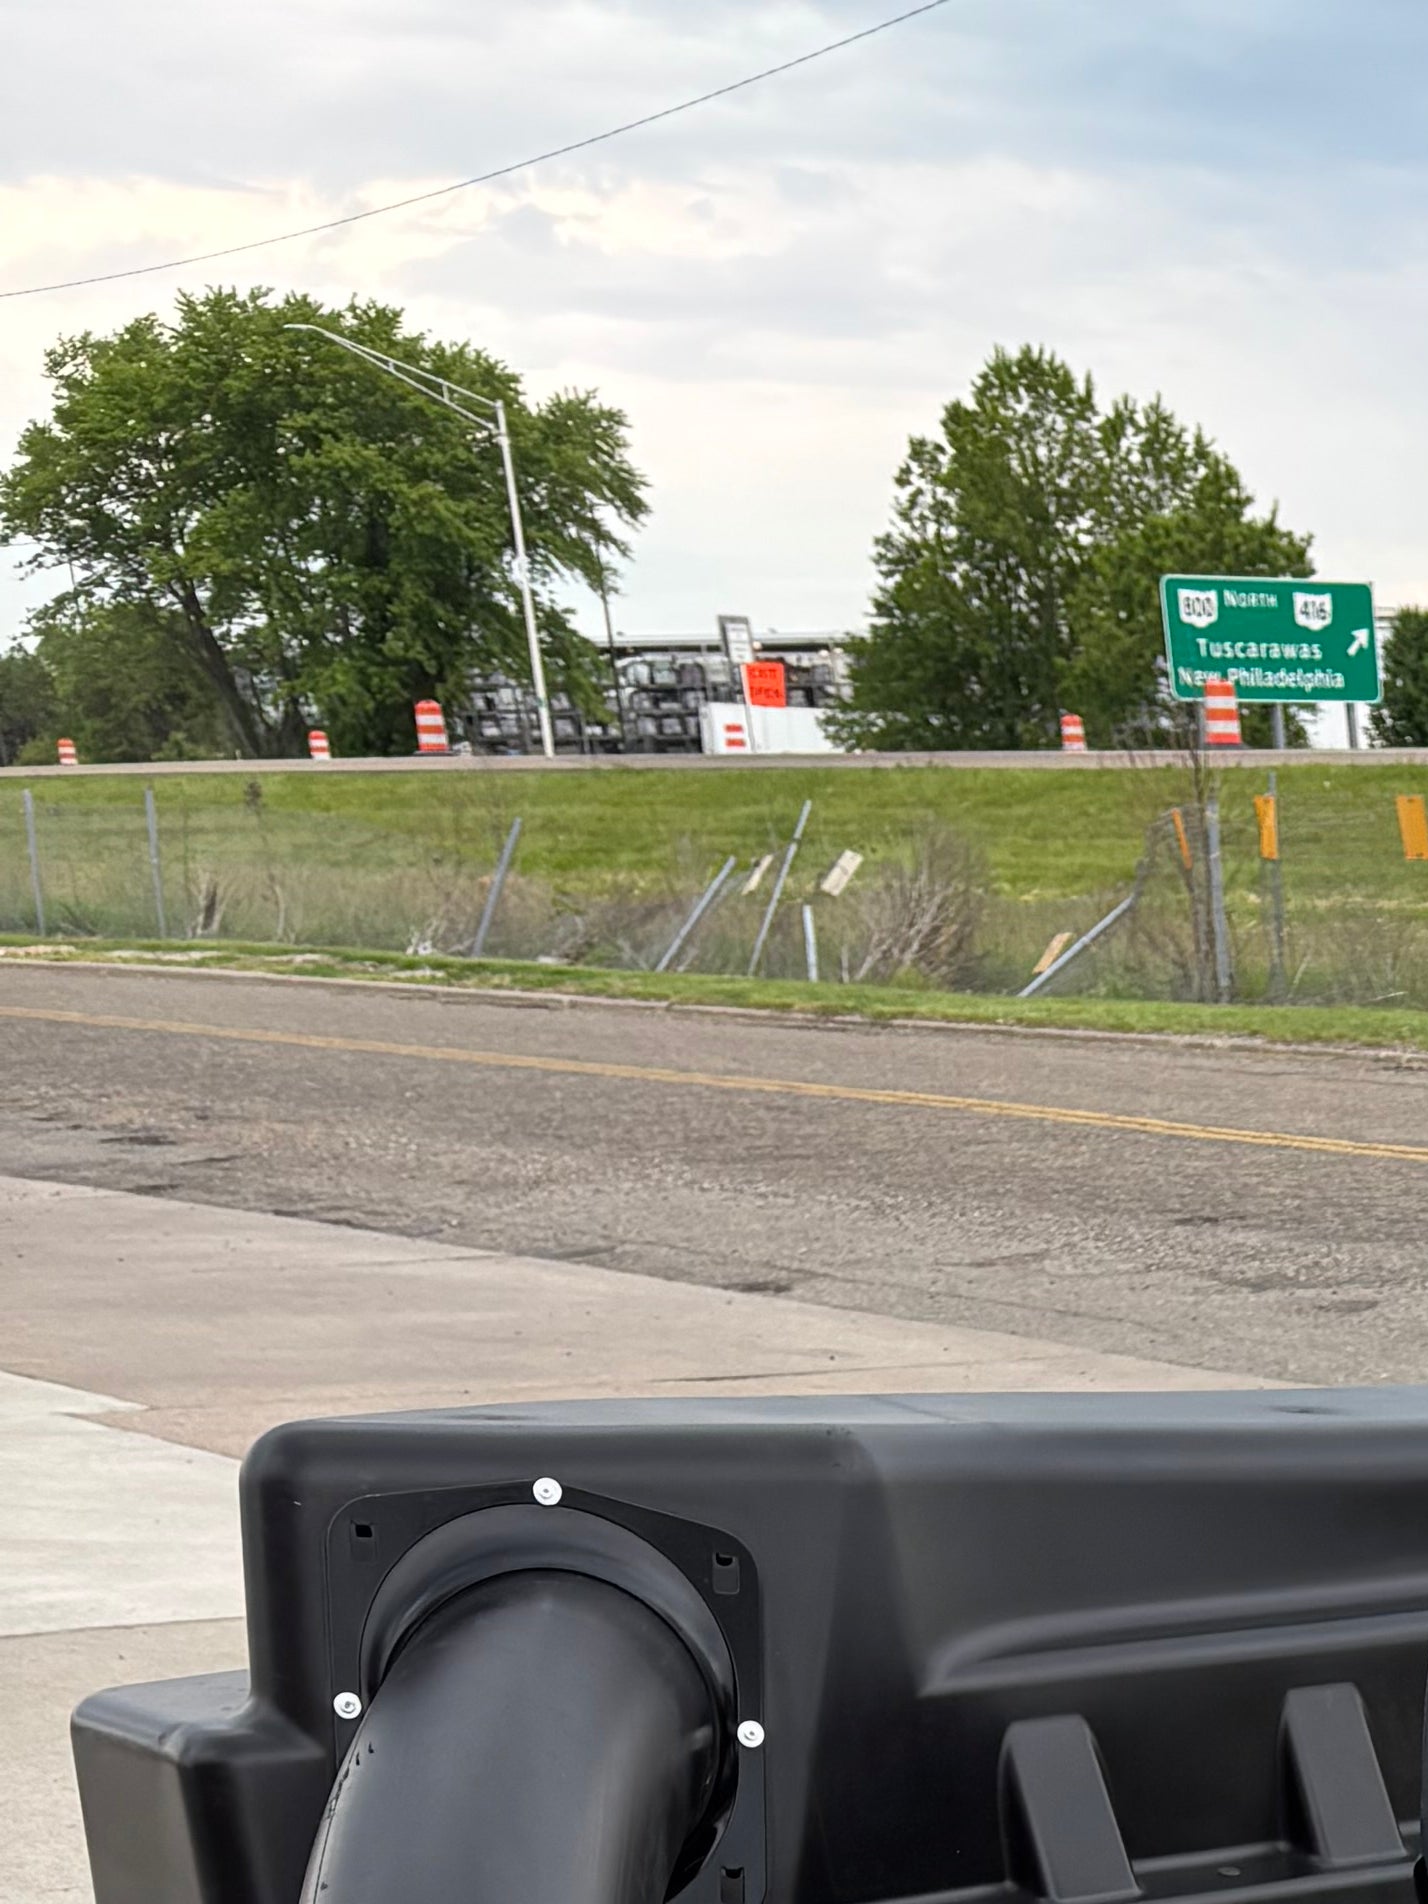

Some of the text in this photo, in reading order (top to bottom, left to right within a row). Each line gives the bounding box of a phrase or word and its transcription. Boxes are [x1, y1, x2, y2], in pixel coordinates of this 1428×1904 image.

[1183, 596, 1213, 617] 800
[1300, 600, 1327, 621] 416
[1196, 638, 1323, 660] Tuscarawas
[1227, 668, 1345, 693] Philadelphia
